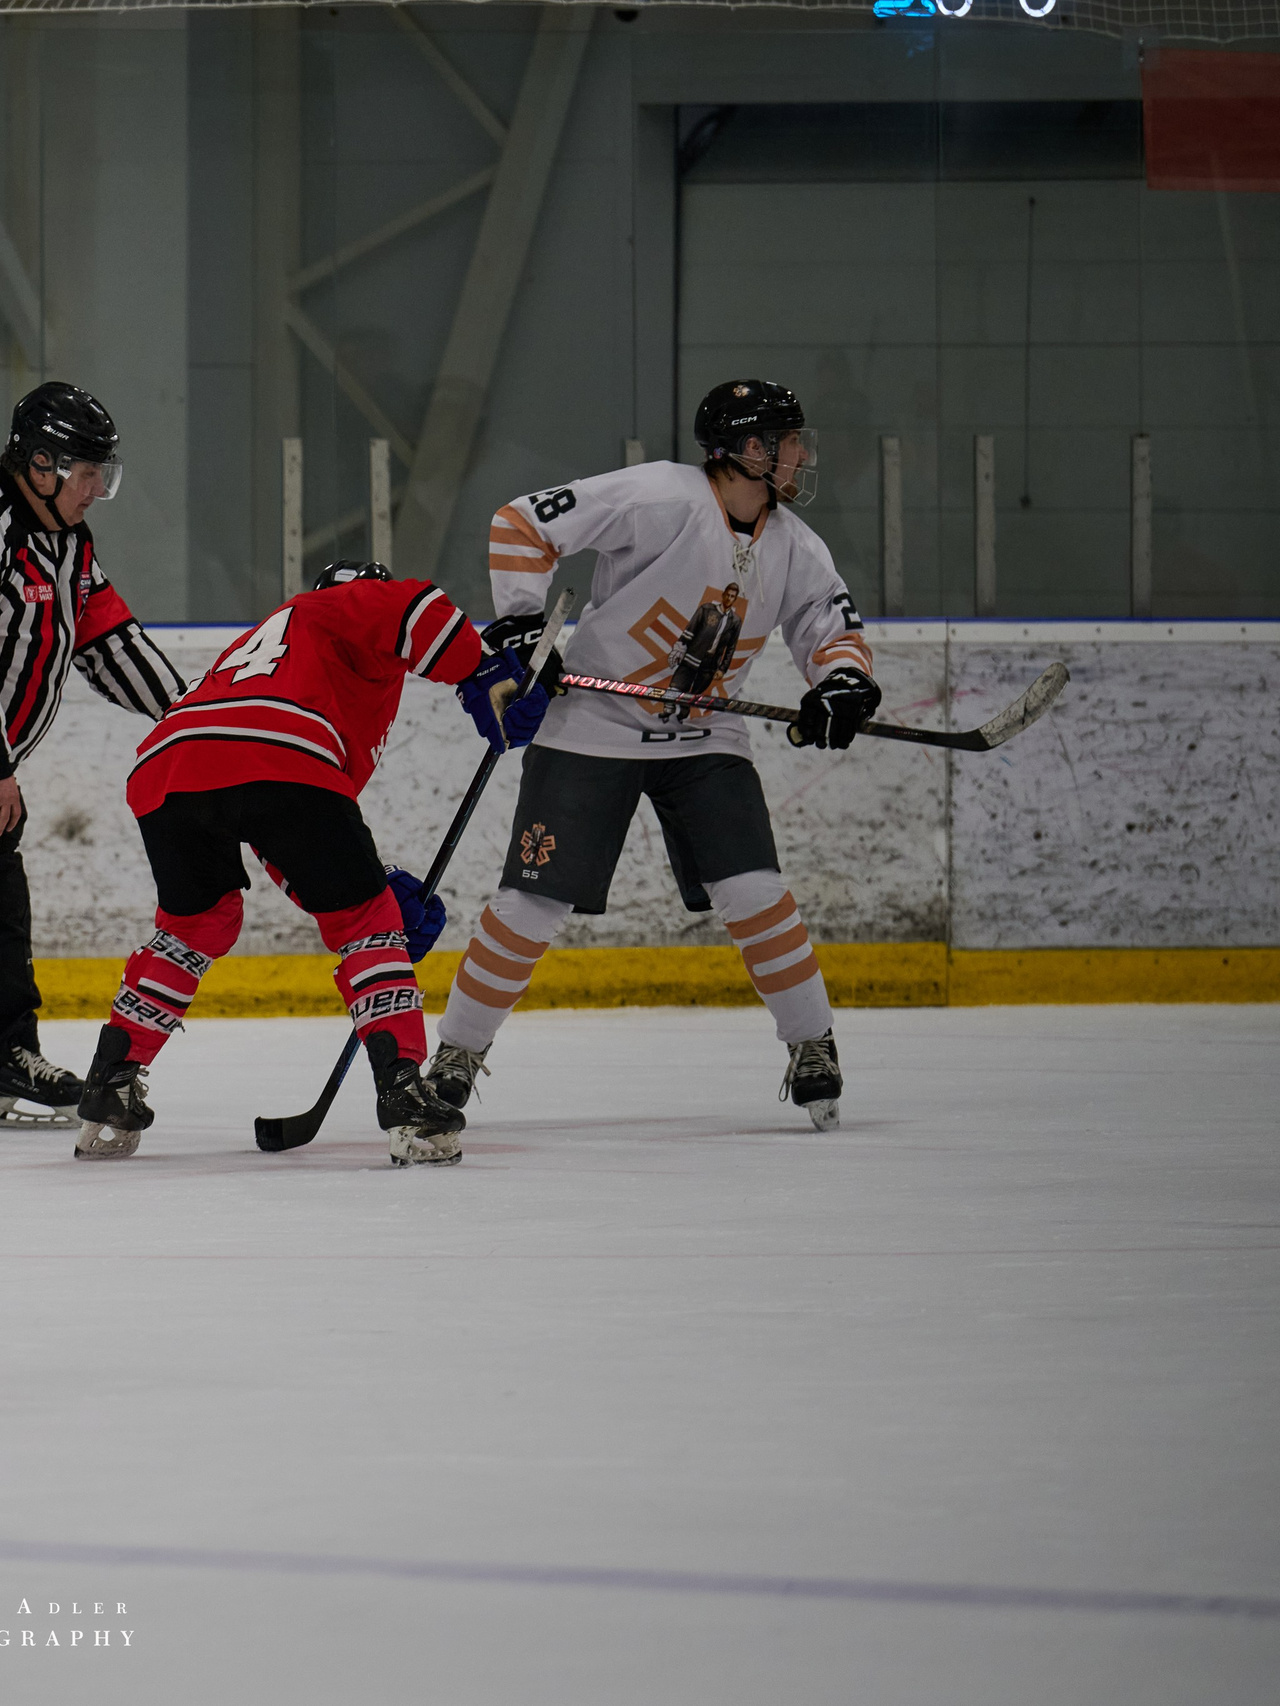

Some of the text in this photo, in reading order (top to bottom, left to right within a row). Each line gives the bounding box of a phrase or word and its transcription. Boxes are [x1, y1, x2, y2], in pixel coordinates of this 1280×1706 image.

[731, 415, 758, 426] CCM
[38, 584, 53, 593] SILK
[39, 592, 53, 601] WAY
[502, 628, 543, 650] CC
[177, 605, 296, 703] 4
